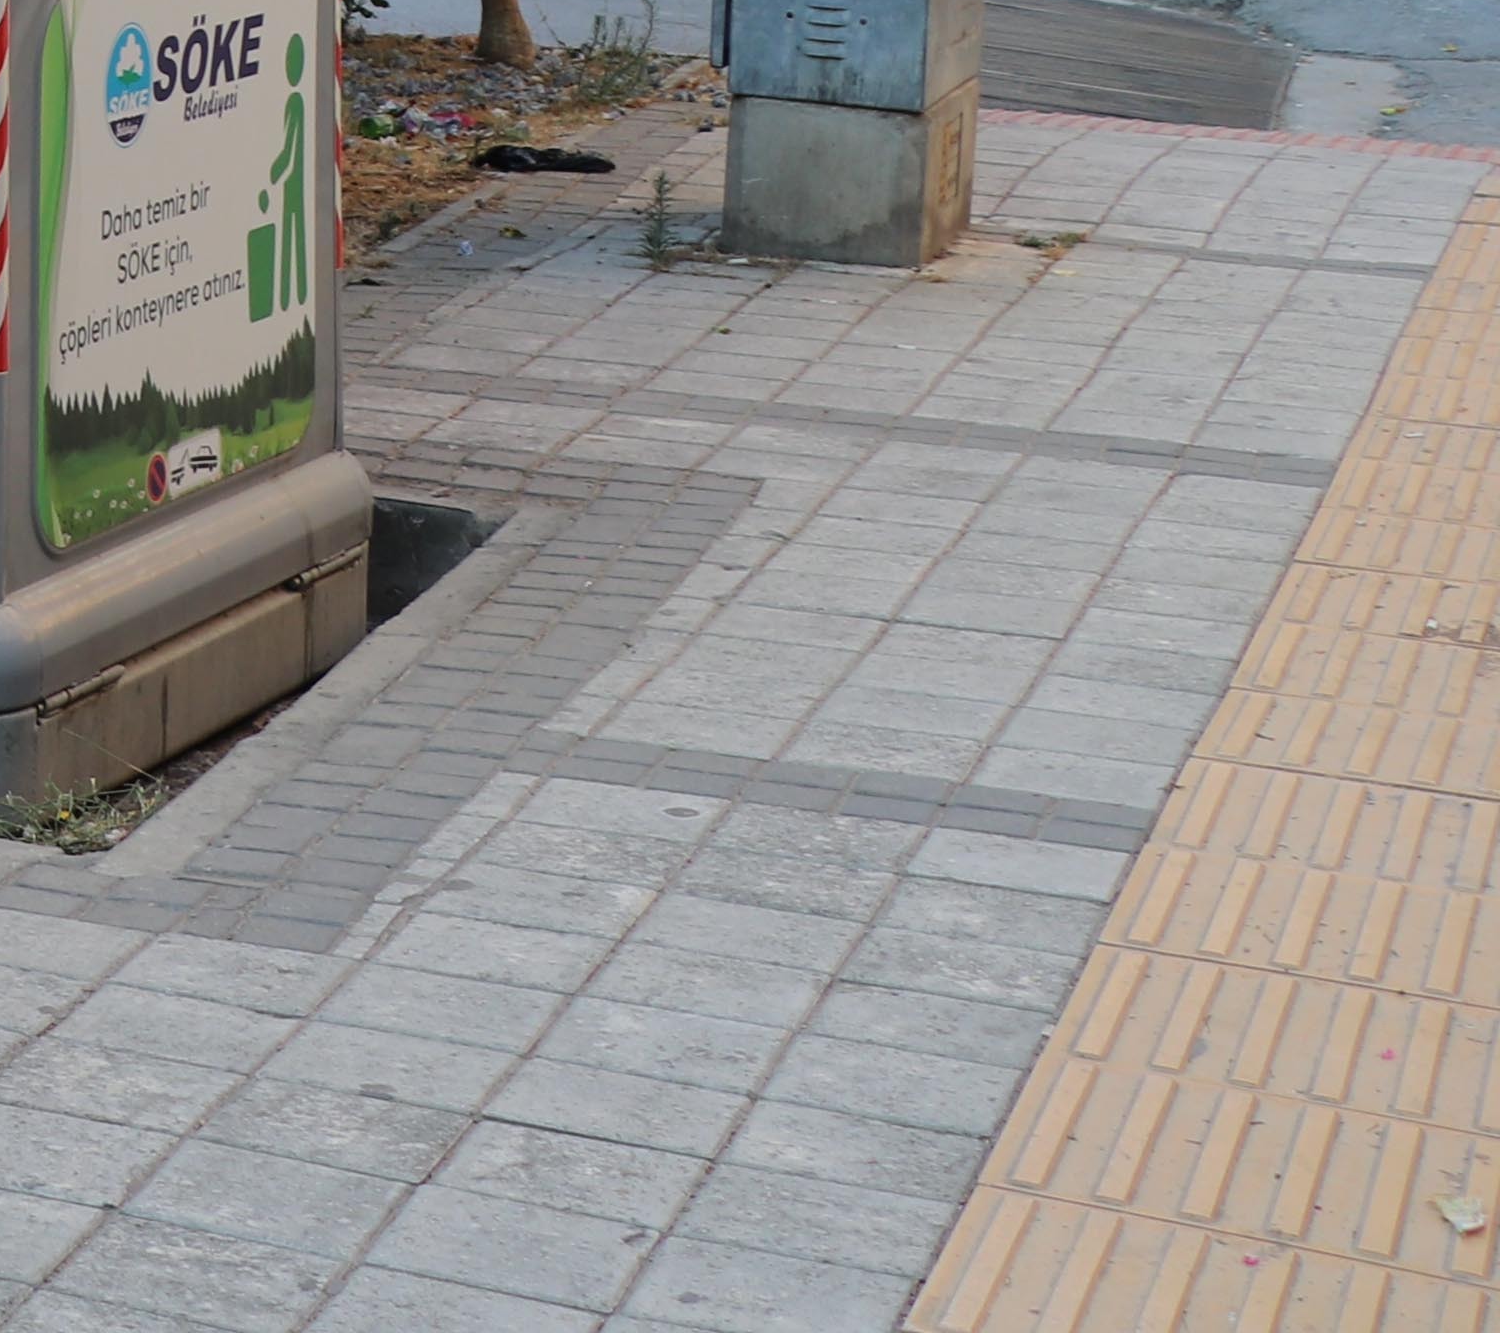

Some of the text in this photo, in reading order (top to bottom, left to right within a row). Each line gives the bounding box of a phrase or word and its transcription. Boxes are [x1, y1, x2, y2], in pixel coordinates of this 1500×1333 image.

[153, 13, 265, 103] SÖKE
[109, 87, 150, 115] SÖKE
[183, 86, 239, 123] Belediyesi
[101, 180, 211, 241] Daha temiz bir
[117, 237, 194, 285] SÖKE için,
[59, 267, 246, 365] çöpleri konteynere atınız.
